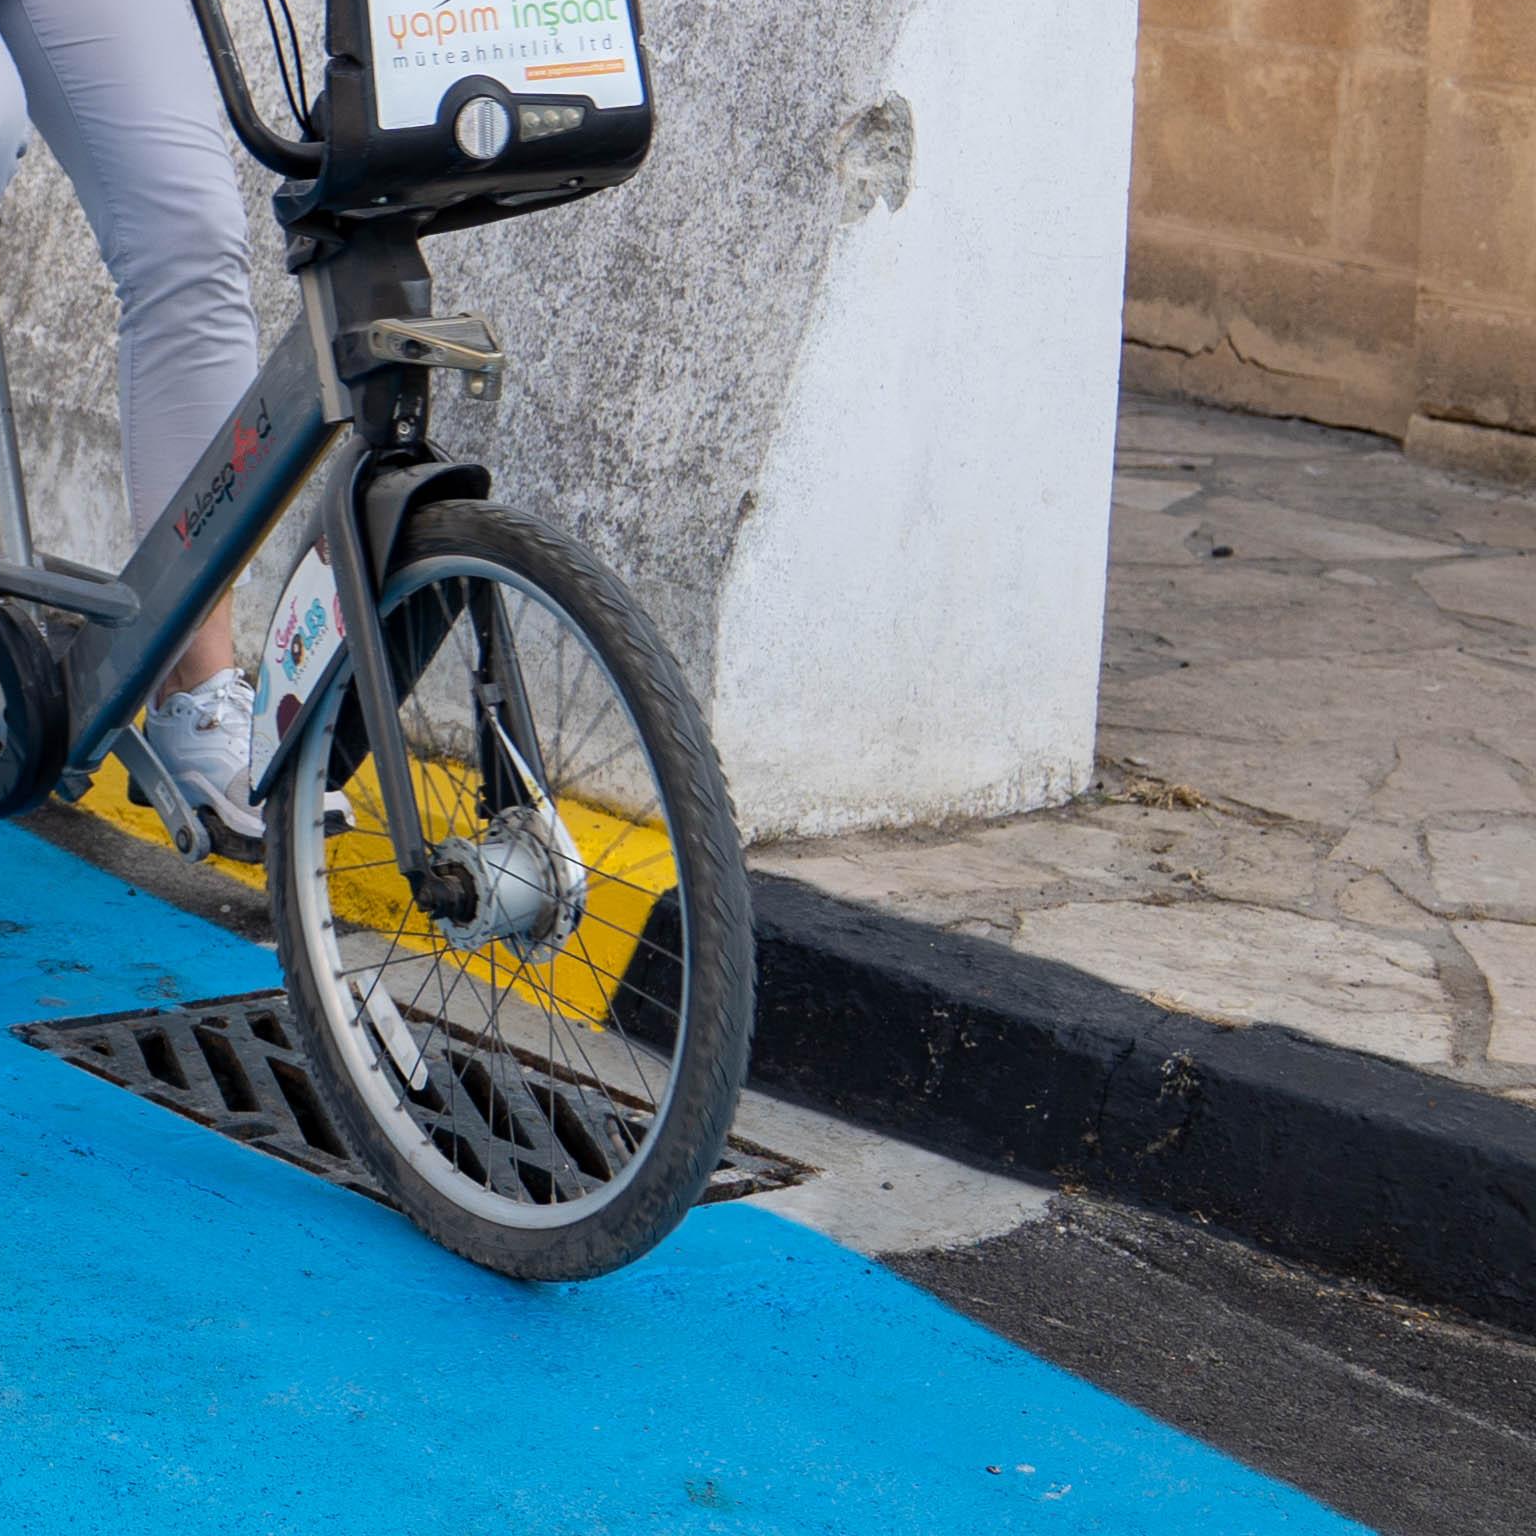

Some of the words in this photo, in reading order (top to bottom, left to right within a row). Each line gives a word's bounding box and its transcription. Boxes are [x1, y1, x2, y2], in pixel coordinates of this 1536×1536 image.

[387, 5, 499, 50] yapım
[392, 43, 564, 69] müteahhitlik
[579, 36, 624, 53] ltd.
